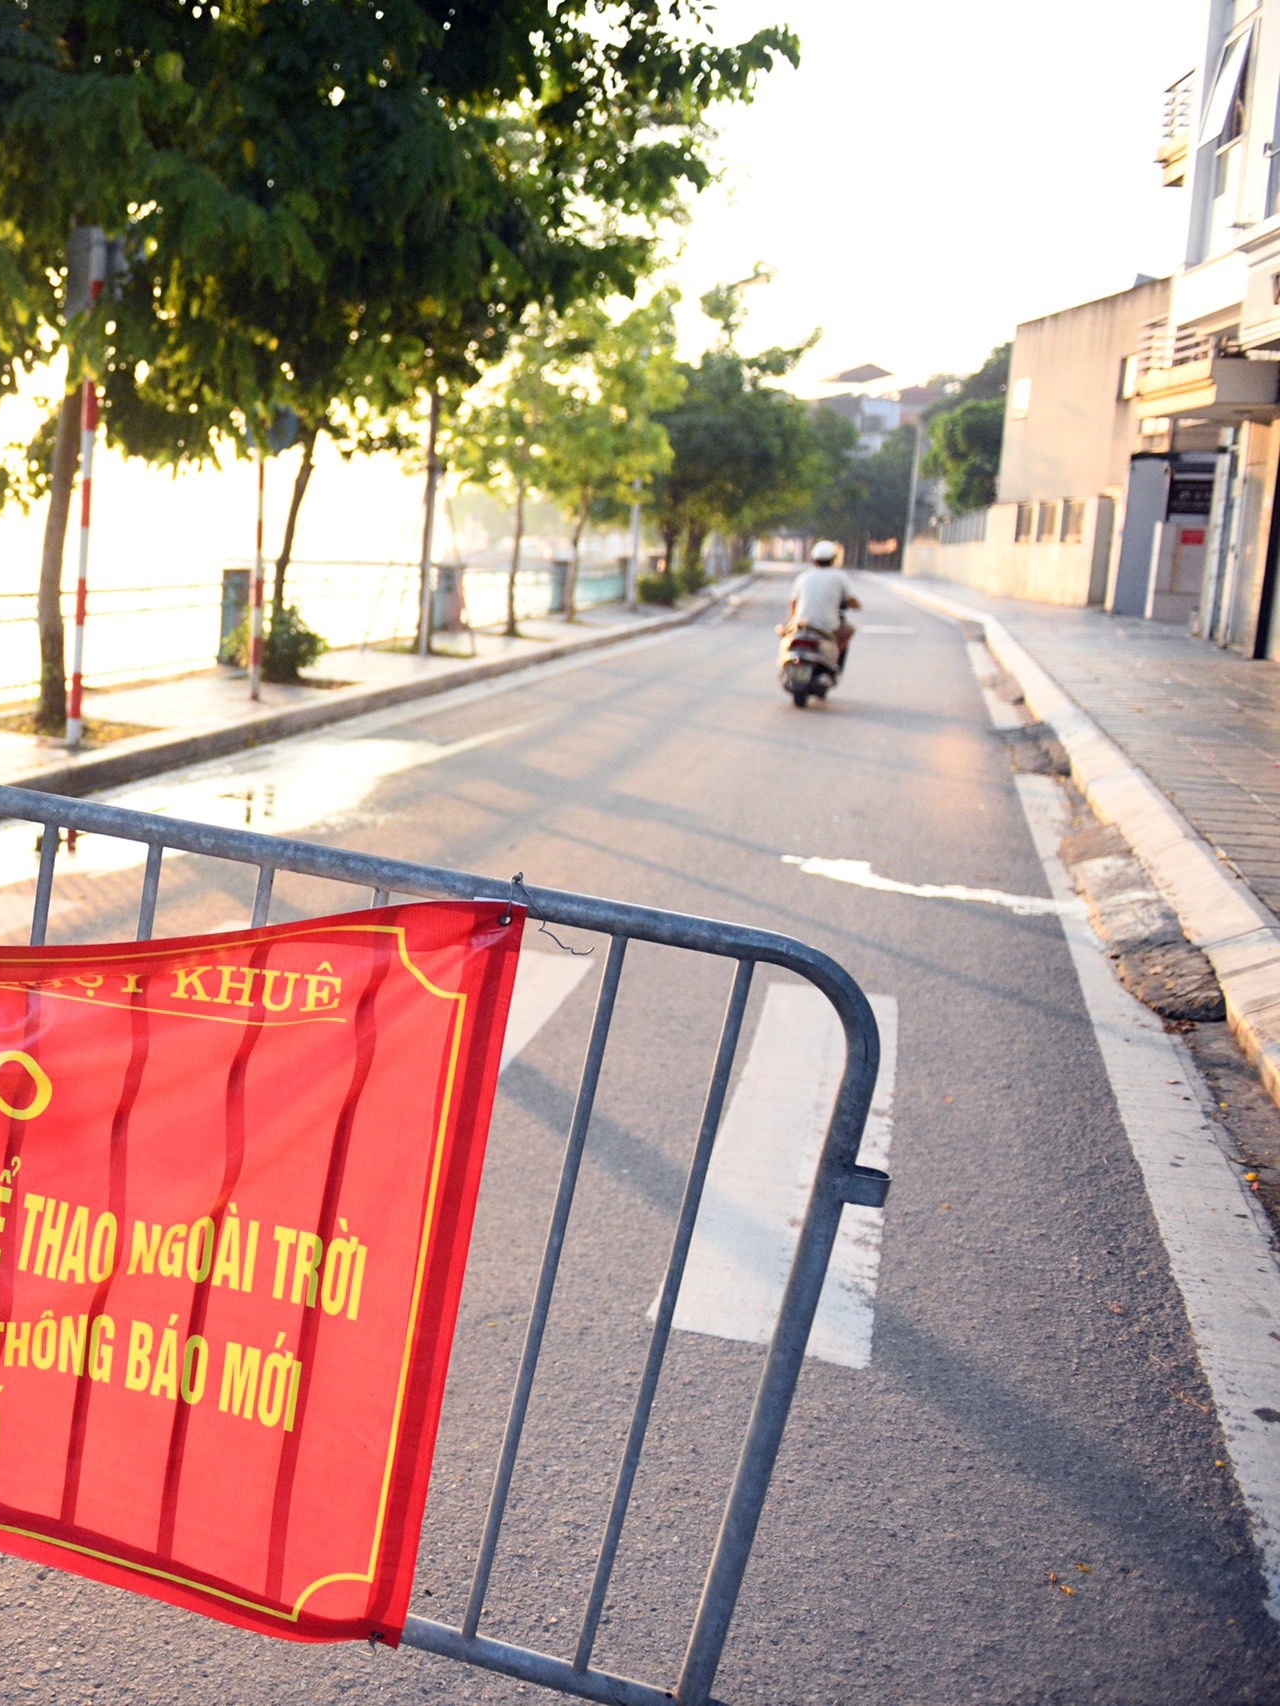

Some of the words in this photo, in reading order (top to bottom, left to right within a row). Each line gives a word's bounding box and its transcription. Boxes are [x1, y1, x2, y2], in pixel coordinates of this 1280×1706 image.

[170, 961, 342, 1012] KHUÊ
[17, 1192, 118, 1285] THAO
[126, 1202, 260, 1293] NGOÀI
[272, 1217, 368, 1321] TRỜI
[125, 1313, 209, 1405] BÁO
[218, 1331, 303, 1433] MỚI
